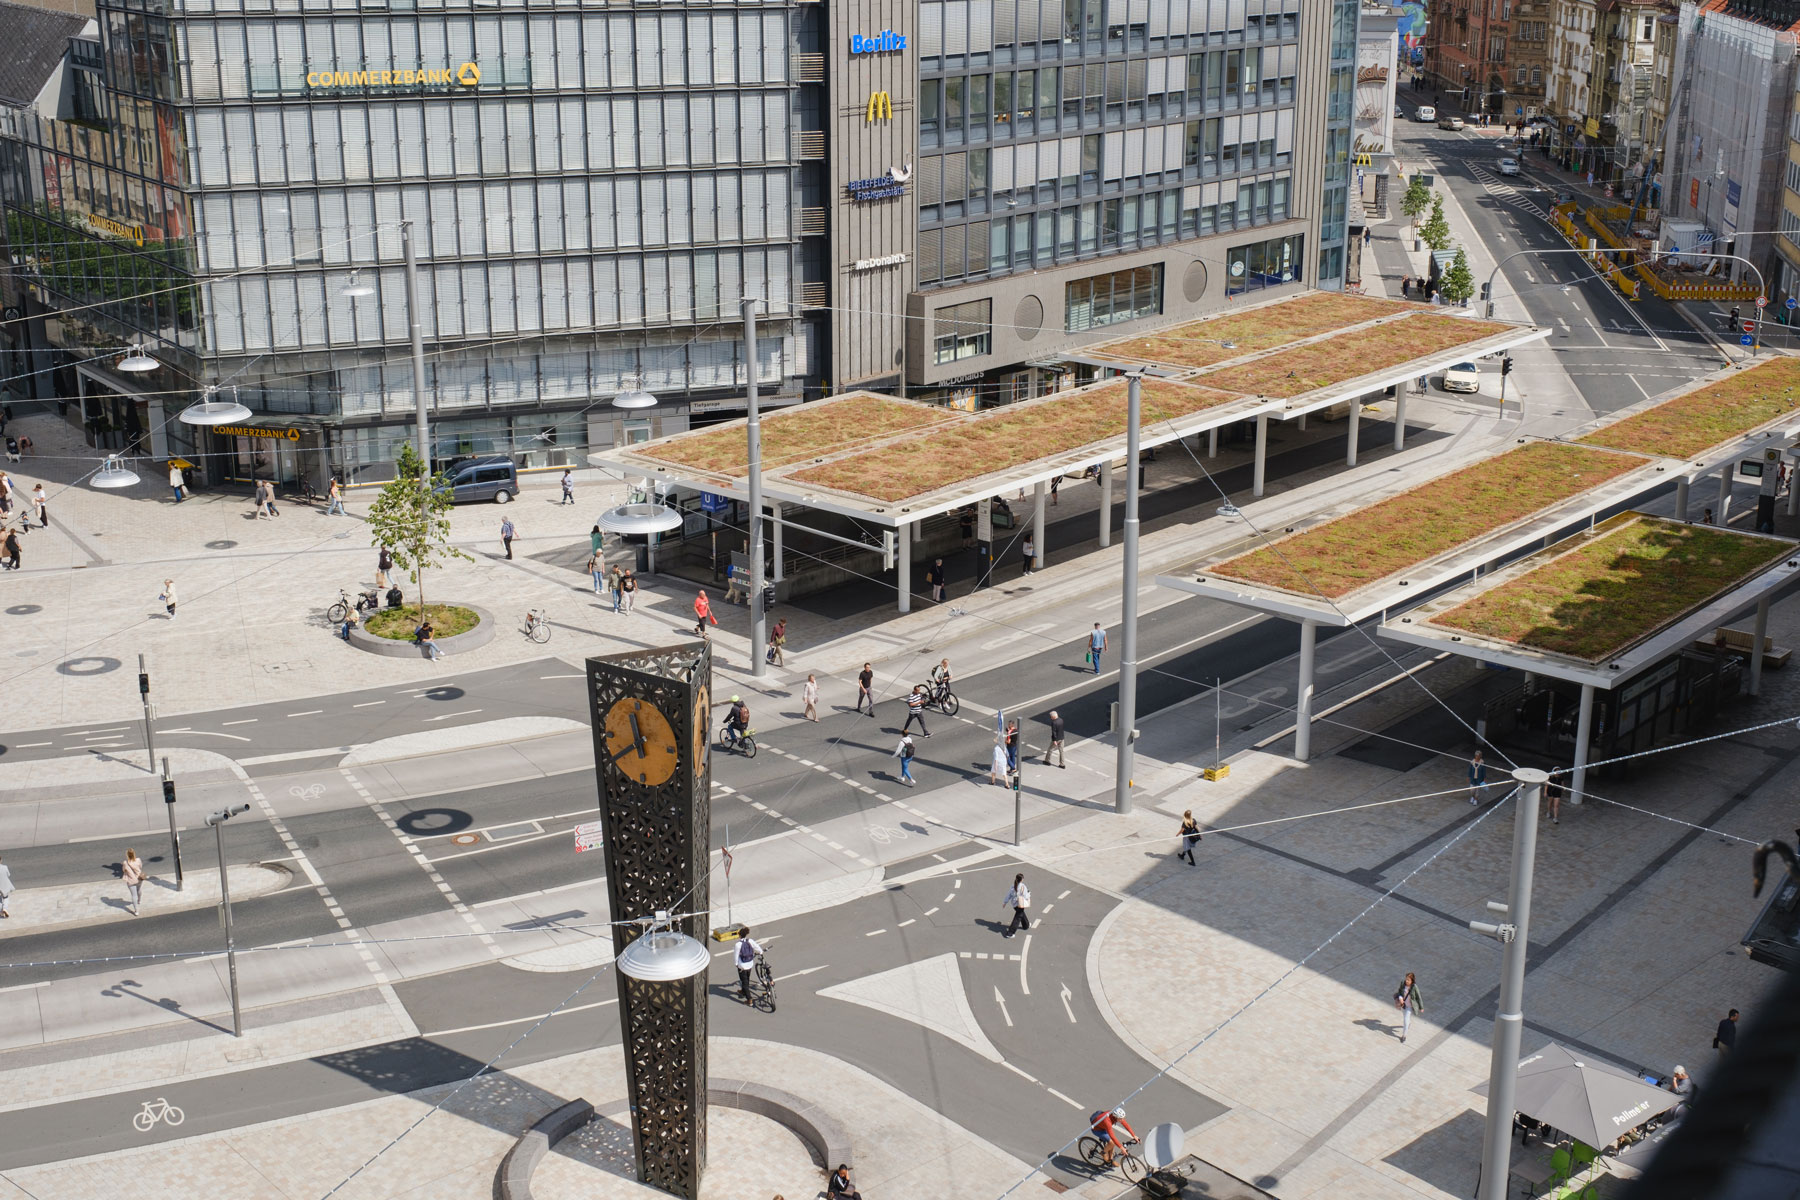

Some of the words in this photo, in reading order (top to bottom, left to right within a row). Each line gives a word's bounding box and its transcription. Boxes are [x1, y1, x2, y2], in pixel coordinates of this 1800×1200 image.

[853, 29, 907, 54] Berlitz
[307, 69, 452, 87] COMMERZBANK
[849, 176, 895, 191] BIELEFELDER
[88, 213, 135, 240] COMMERZBANK
[856, 253, 906, 270] McDonald's
[213, 424, 286, 439] COMMERZBANK
[704, 493, 711, 503] U
[1611, 1100, 1651, 1126] Pollmeier
